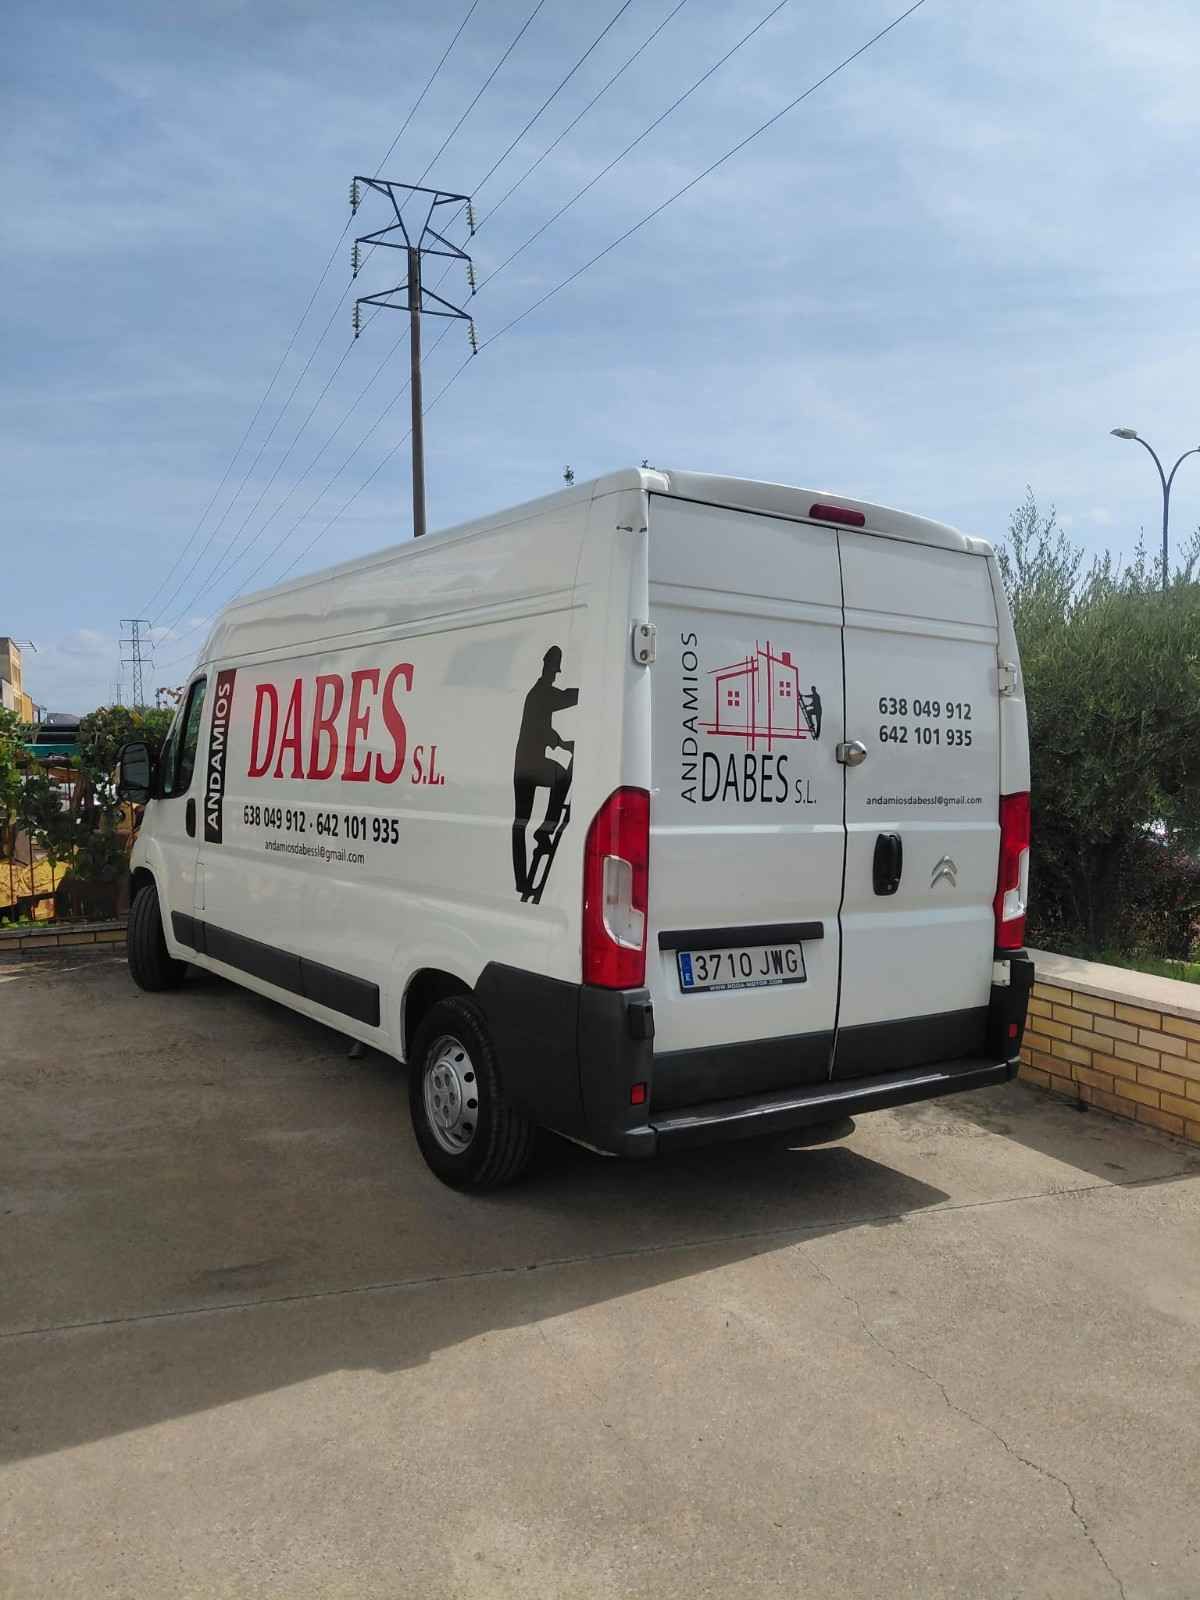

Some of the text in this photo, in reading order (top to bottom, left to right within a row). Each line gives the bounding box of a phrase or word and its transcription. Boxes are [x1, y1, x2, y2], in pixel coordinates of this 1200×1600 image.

[247, 663, 445, 785] DABES S.L.
[681, 632, 698, 803] ANDAMIOS
[879, 697, 972, 720] 638 049 912
[879, 725, 972, 747] 642 101 935
[207, 682, 230, 831] ANDAMIOS
[701, 752, 817, 804] DABES S.L.
[866, 795, 983, 807] andamiosdabessl@gmail.com
[243, 804, 261, 826] 638
[263, 808, 283, 830] 049
[286, 811, 306, 833] 912
[316, 814, 339, 837] 642
[344, 815, 367, 840] 101
[372, 818, 400, 845] 935
[264, 839, 365, 864] andamiosdabessl@gmail.com
[695, 949, 798, 981] 3710 JWG
